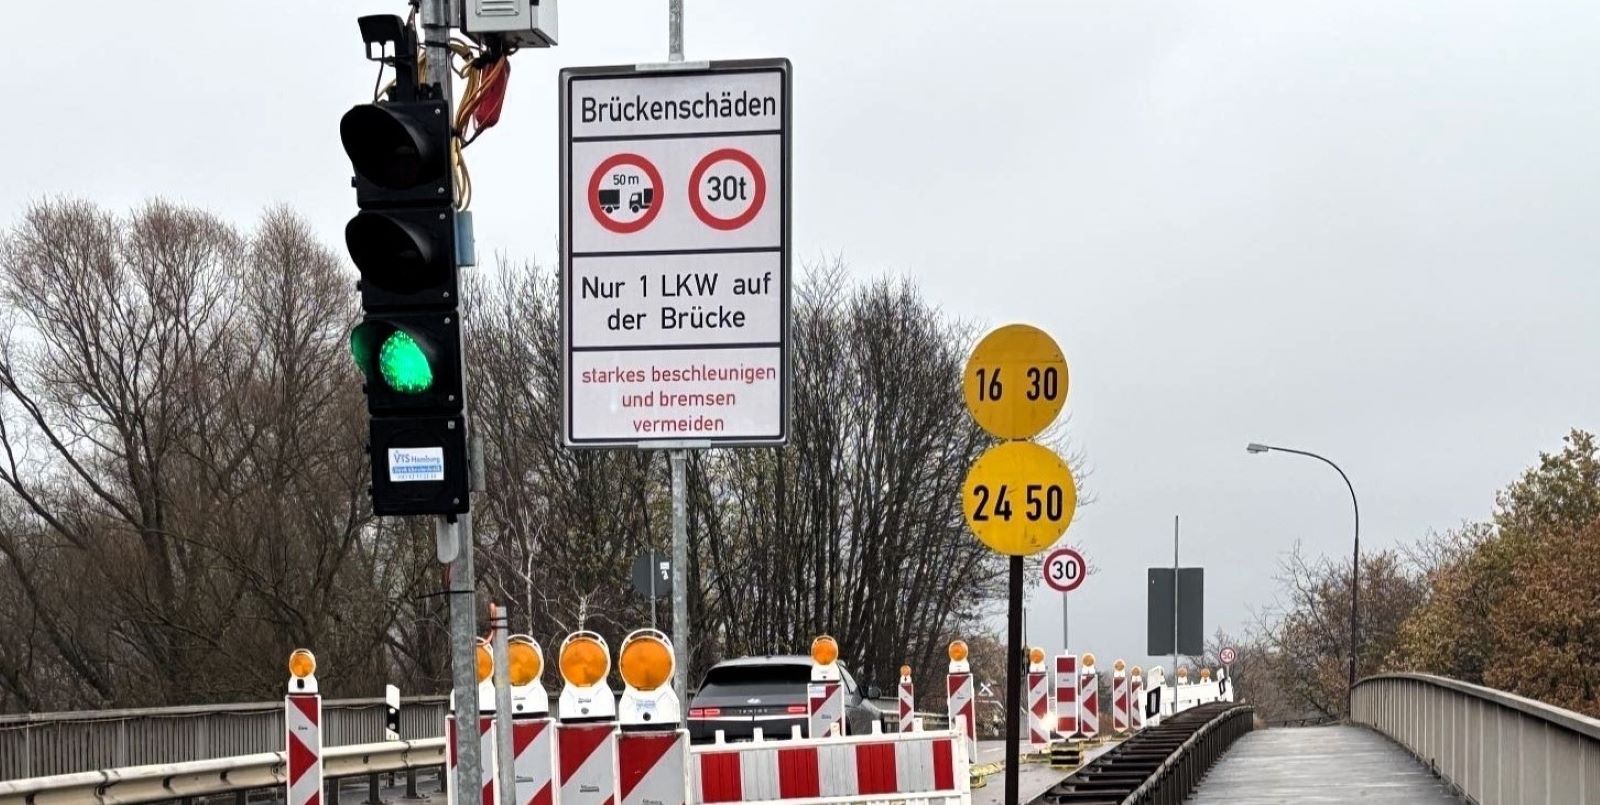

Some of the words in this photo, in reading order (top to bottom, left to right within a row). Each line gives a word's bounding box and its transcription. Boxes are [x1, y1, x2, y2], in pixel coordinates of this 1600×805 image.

[581, 90, 776, 123] Brückenschäden
[612, 173, 629, 186] 50
[630, 175, 640, 185] m
[706, 176, 747, 202] 30t
[582, 276, 626, 299] Nur
[639, 275, 648, 298] 1
[661, 273, 719, 297] LKW
[732, 271, 772, 296] auf
[607, 308, 647, 331] der
[661, 305, 746, 330] Brücke
[581, 366, 645, 384] starkes
[651, 363, 776, 385] beschleunigen
[976, 367, 1003, 402] 16
[1026, 366, 1058, 401] 30
[621, 390, 654, 408] und
[659, 390, 736, 408] bremsen
[633, 415, 724, 433] vermeiden
[972, 484, 1013, 522] 24
[1026, 484, 1063, 522] 50
[1052, 560, 1078, 581] 30
